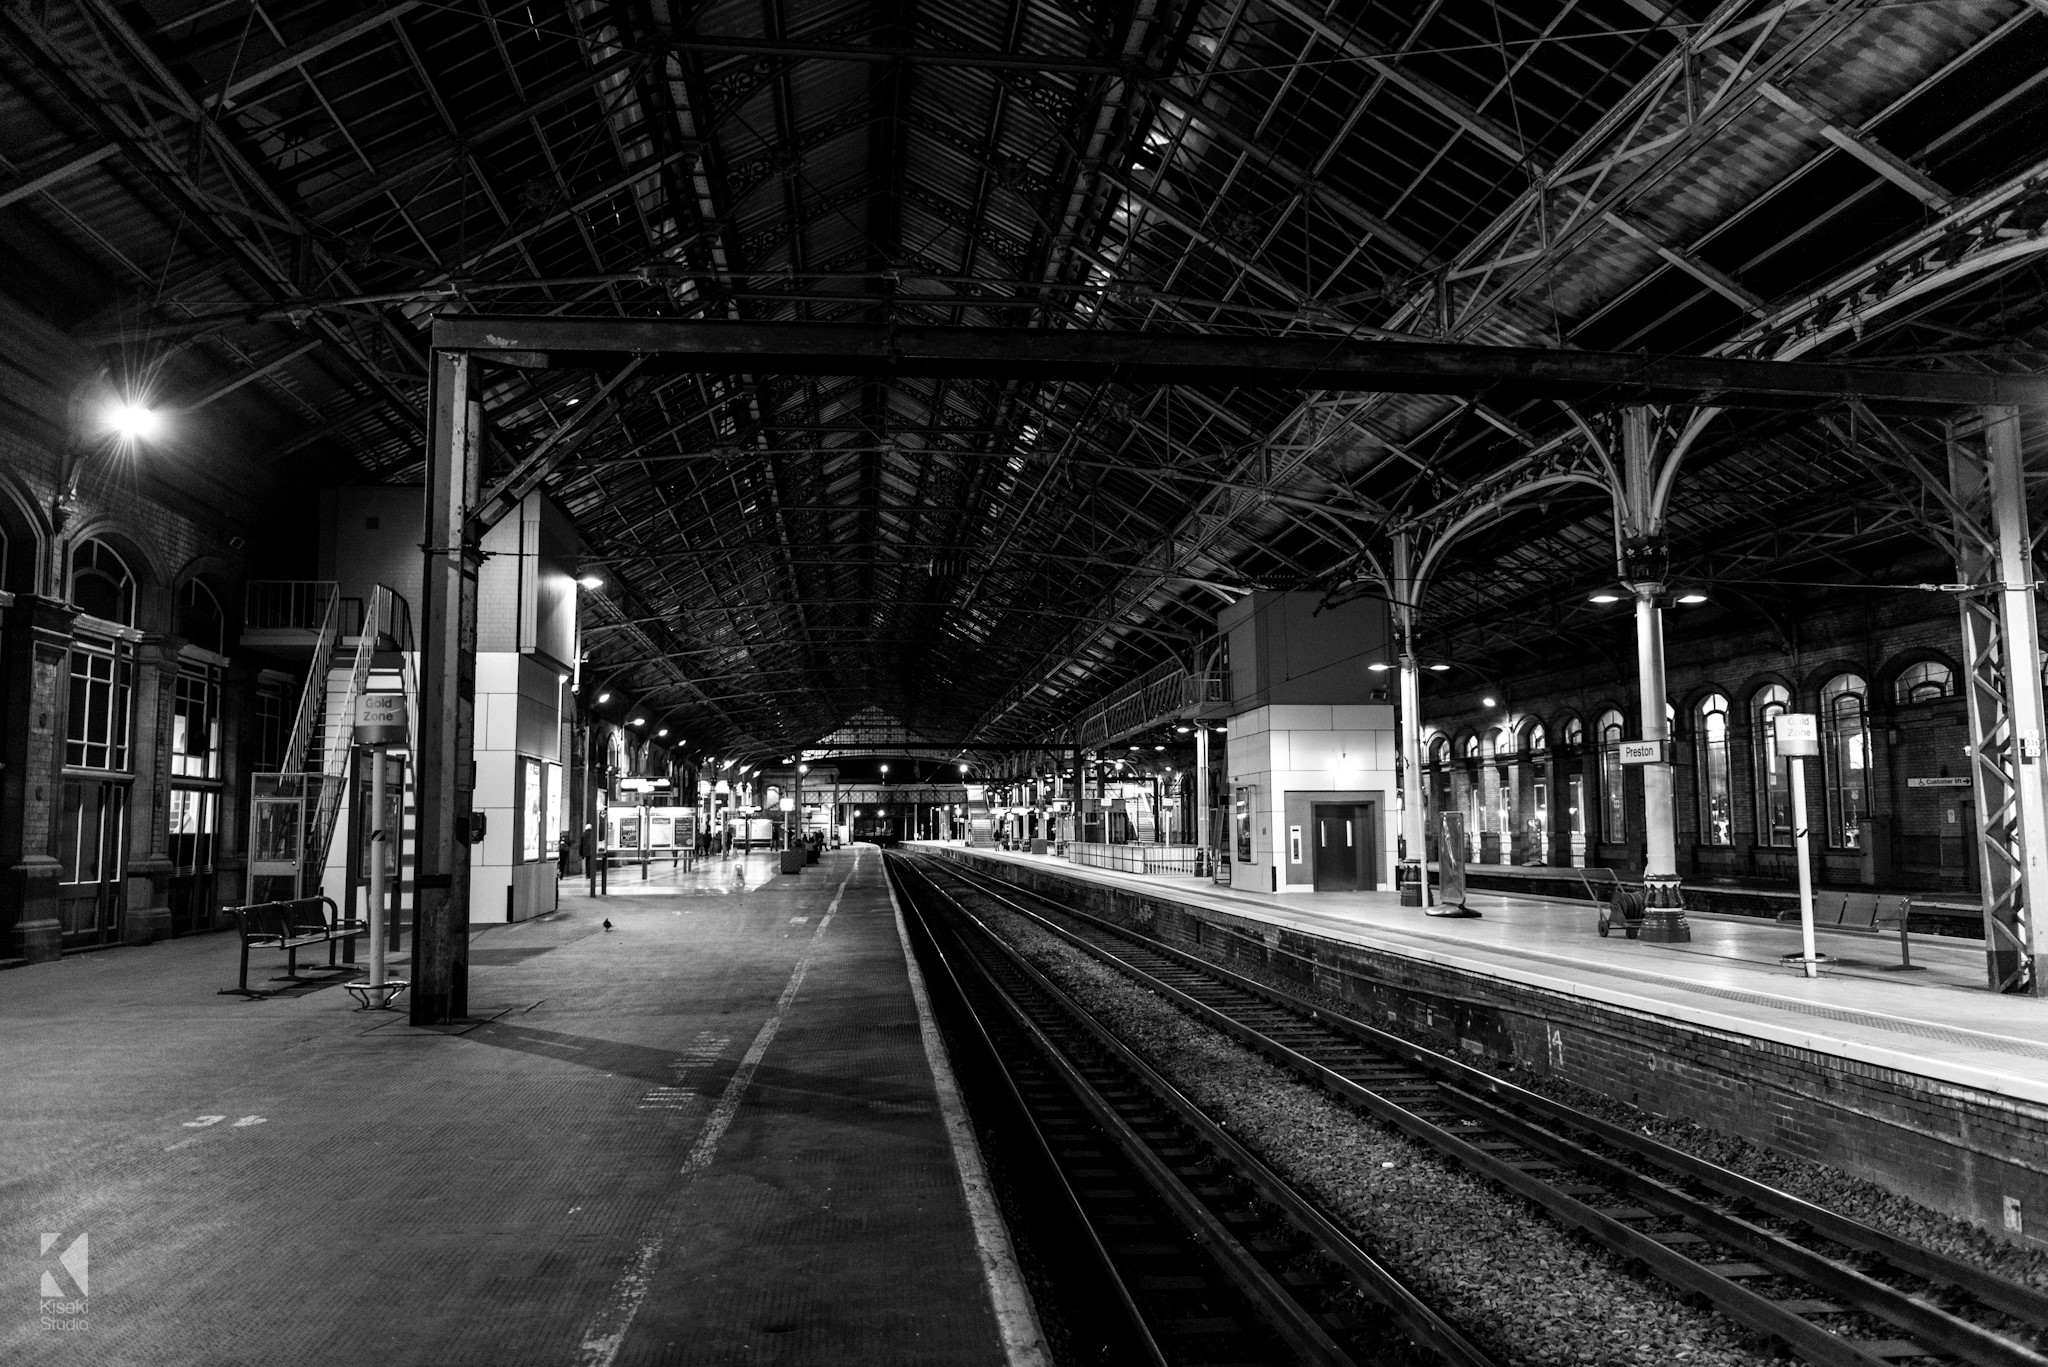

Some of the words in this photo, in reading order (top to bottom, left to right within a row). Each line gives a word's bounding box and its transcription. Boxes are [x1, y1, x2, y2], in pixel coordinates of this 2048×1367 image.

[365, 698, 392, 708] Gold
[363, 711, 394, 721] Zone
[1787, 717, 1810, 726] Gld
[1625, 745, 1654, 758] Preston
